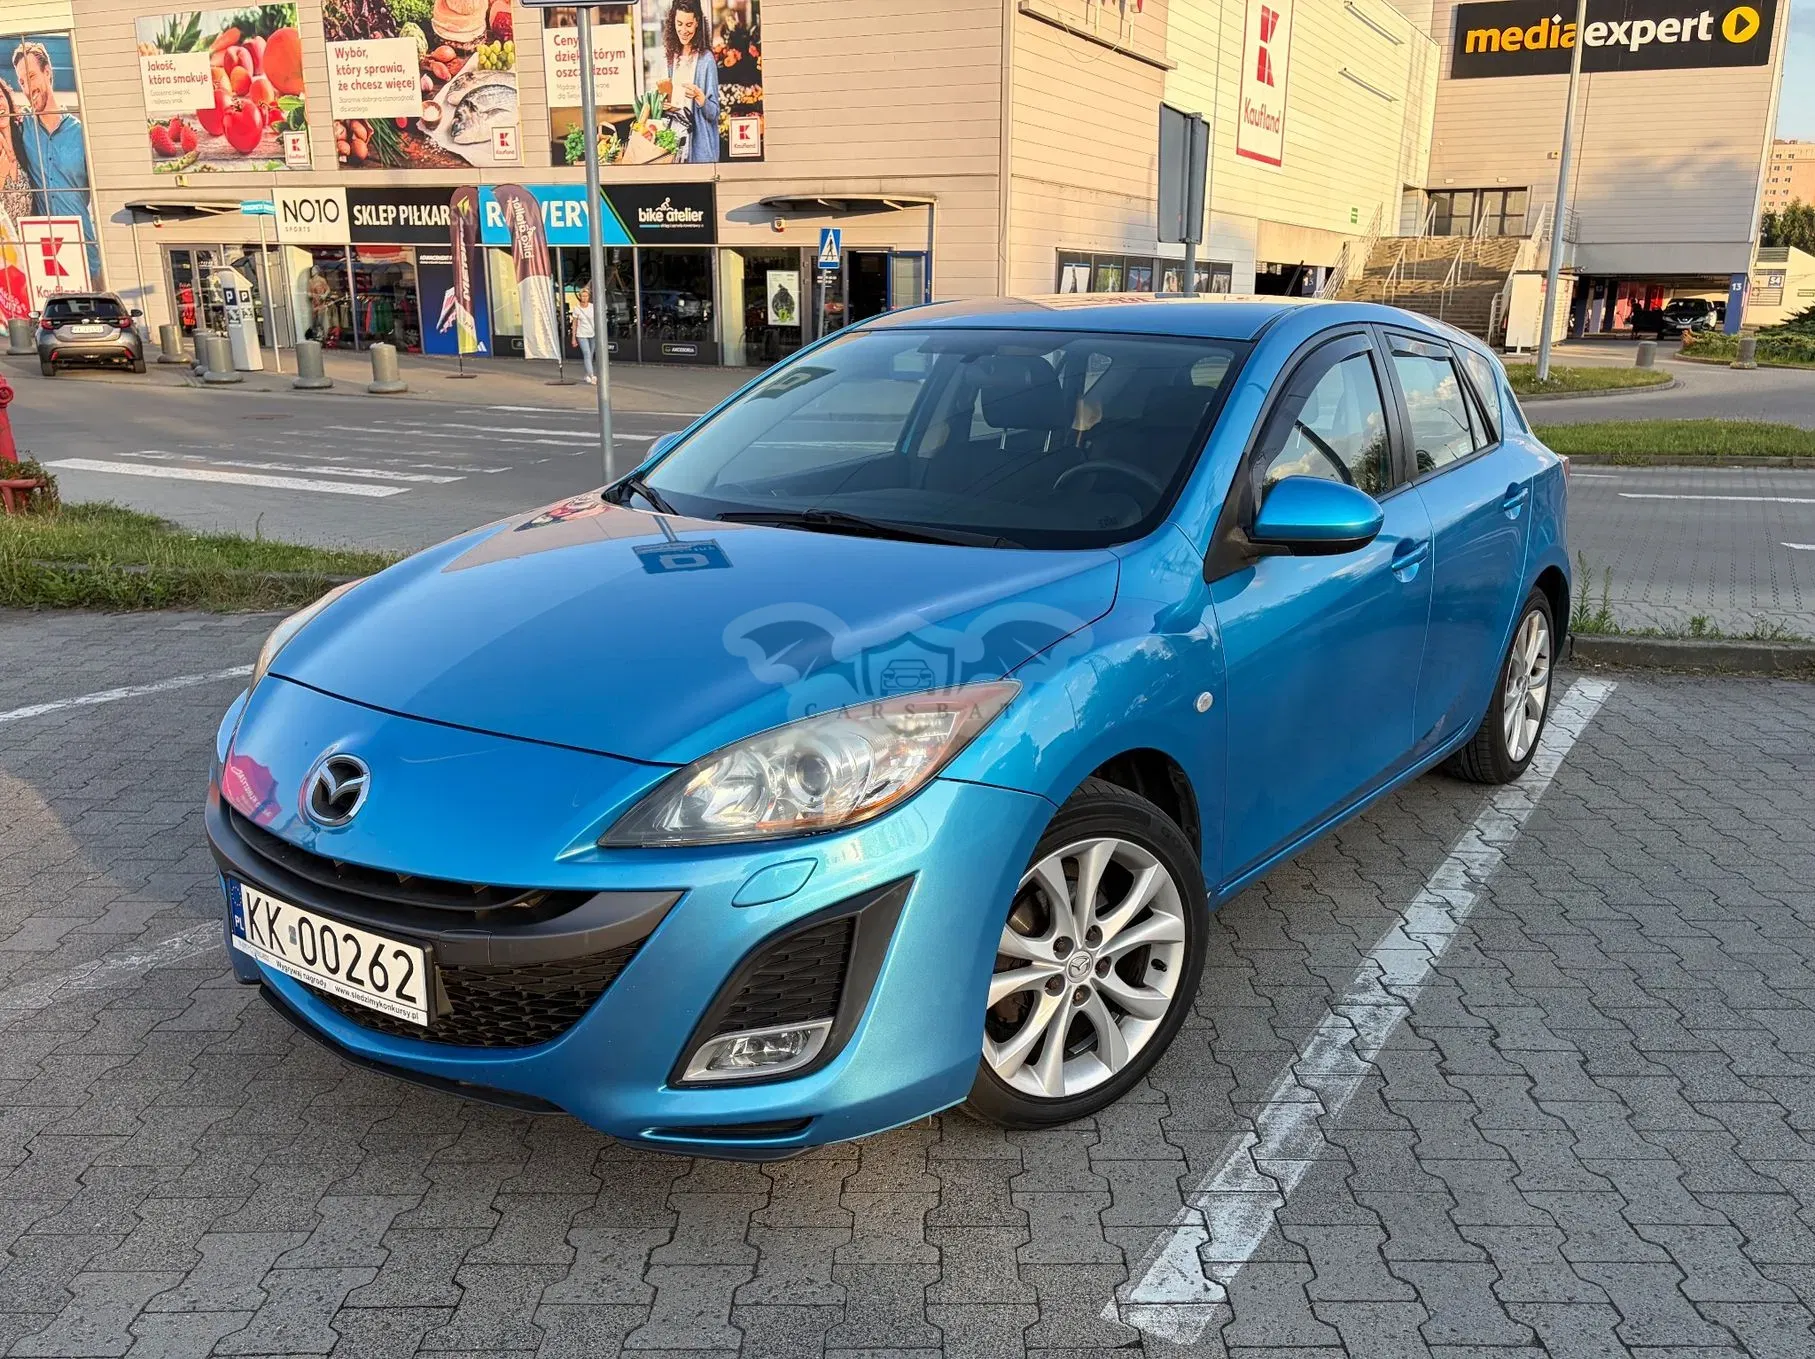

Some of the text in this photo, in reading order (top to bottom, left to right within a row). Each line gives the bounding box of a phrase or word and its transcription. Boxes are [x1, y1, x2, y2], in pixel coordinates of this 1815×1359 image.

[335, 46, 368, 61] Wybór,
[593, 47, 626, 62] tórym
[147, 60, 176, 71] Jakość,
[336, 61, 405, 77] który sprawia,
[149, 72, 208, 85] która smakuje
[338, 76, 415, 91] że chcesz więcej
[1243, 96, 1281, 134] Kaufland
[282, 198, 340, 223] NO10
[353, 204, 397, 226] SKLEP
[638, 207, 704, 222] bike atelier
[235, 914, 245, 931] PL
[246, 892, 418, 1005] KK 00262
[303, 972, 328, 989] nagrody
